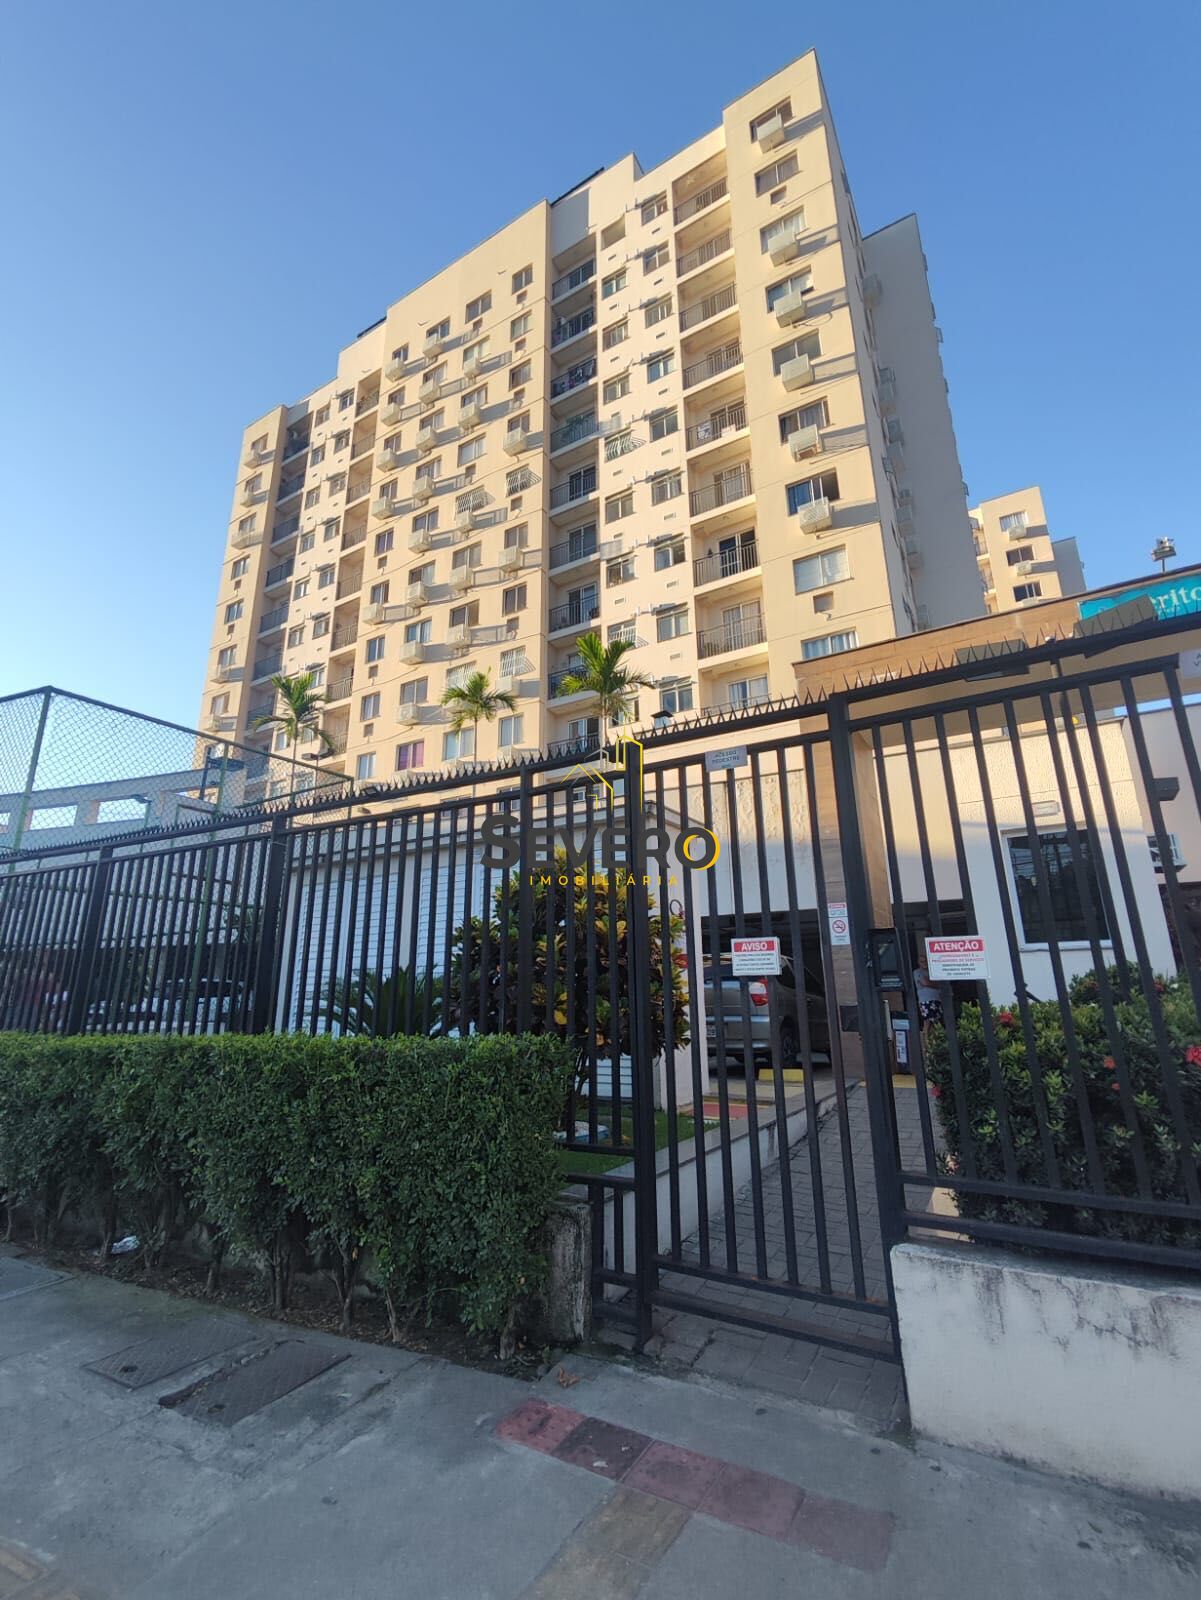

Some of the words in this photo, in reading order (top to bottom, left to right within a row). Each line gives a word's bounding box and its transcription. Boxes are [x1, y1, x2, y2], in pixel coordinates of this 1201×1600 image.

[711, 755, 740, 764] PEDESTRE
[741, 942, 768, 951] AVISO
[933, 940, 979, 951] ATENÇÃO
